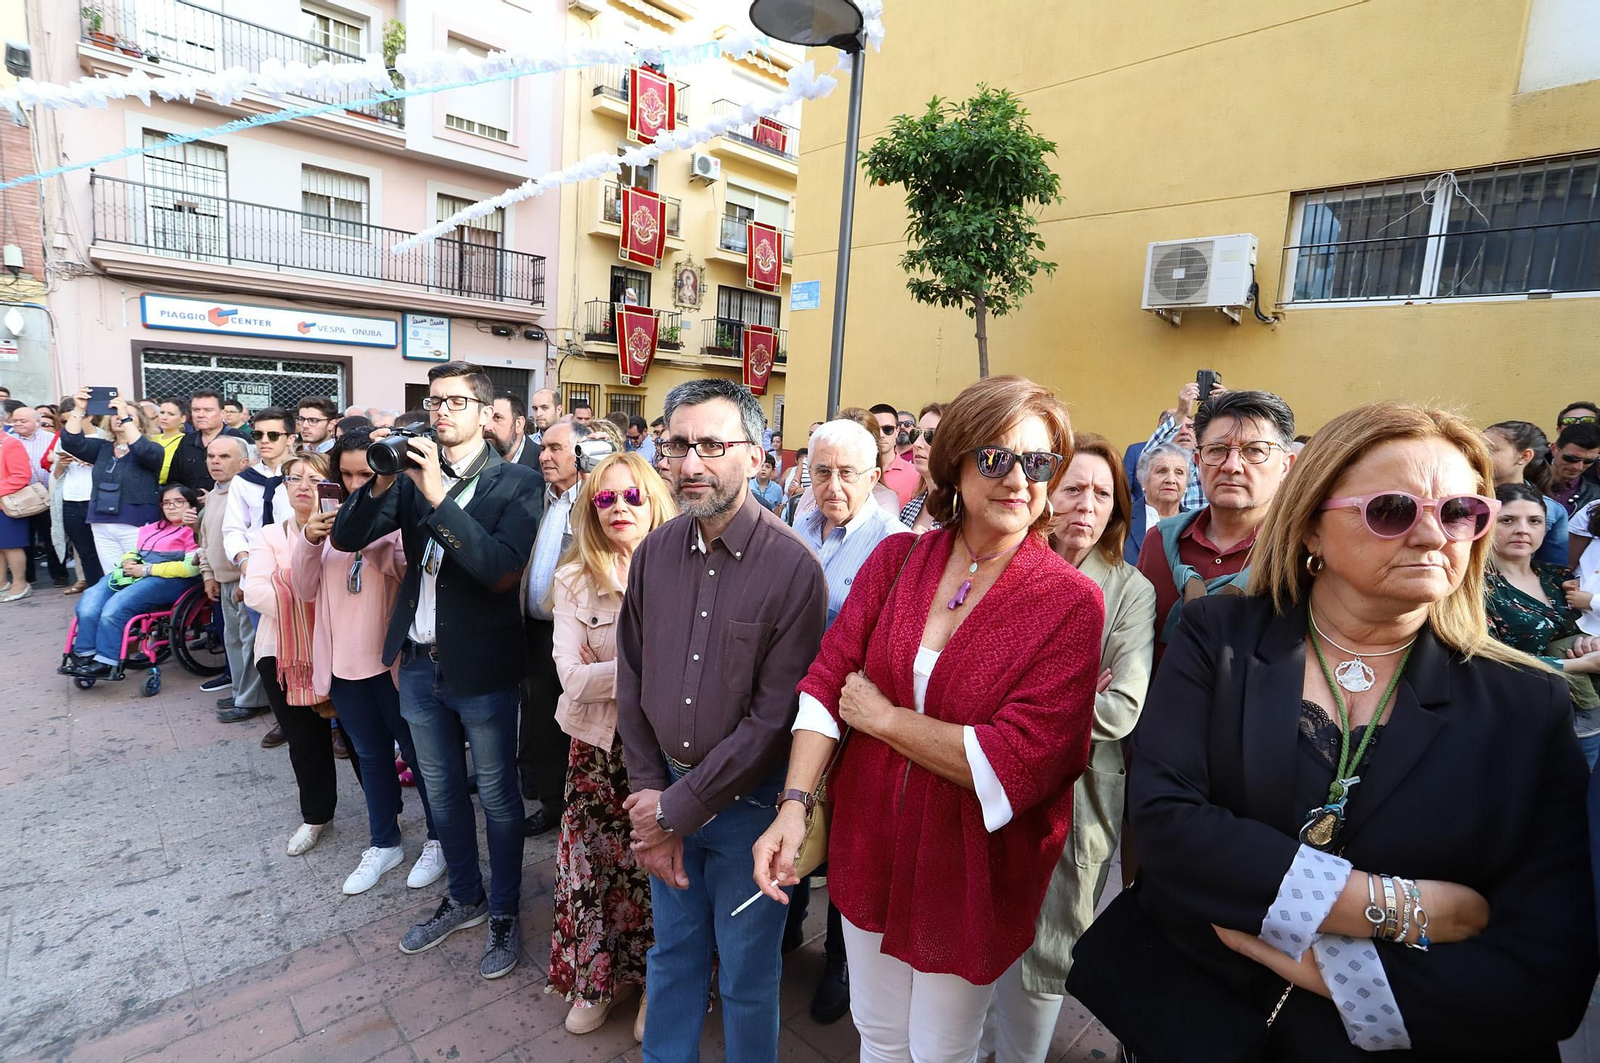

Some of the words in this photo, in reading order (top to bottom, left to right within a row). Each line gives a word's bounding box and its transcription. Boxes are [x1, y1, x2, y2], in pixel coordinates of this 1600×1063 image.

[160, 310, 206, 321] PIAGGIO
[231, 317, 272, 327] CENTER
[317, 325, 346, 334] VESPA
[352, 328, 382, 337] ONUBA
[227, 383, 238, 393] SE
[241, 384, 269, 395] VENDE
